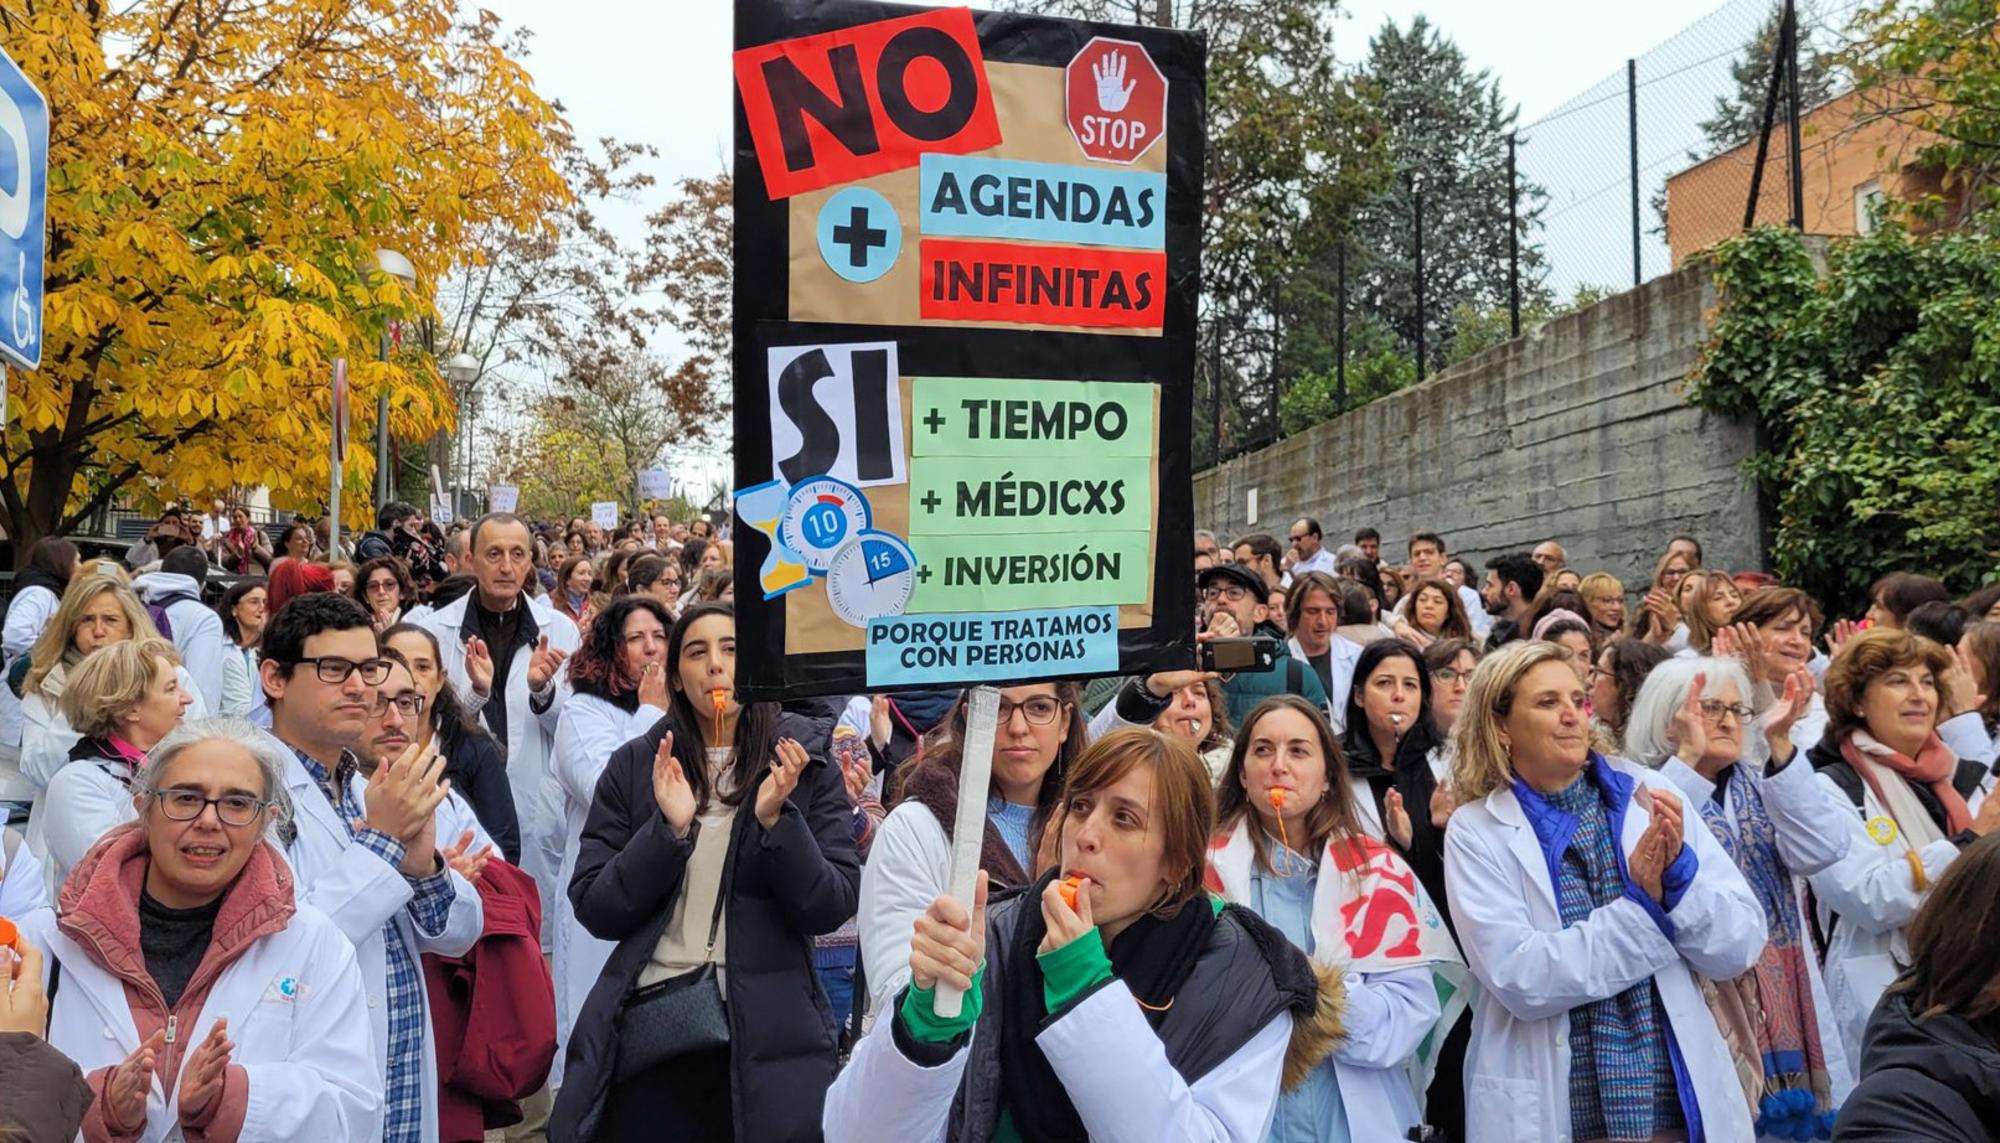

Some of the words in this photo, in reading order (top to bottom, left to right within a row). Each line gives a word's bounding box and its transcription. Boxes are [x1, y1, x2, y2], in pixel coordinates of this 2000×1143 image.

[761, 26, 978, 172] NO
[1080, 115, 1146, 150] STOP
[931, 172, 1154, 228] AGENDAS
[933, 260, 1152, 311] INFINITAS
[777, 348, 893, 483] SI
[961, 399, 1128, 440] TIEMPO
[956, 471, 1125, 517] MÉDICXS
[809, 510, 838, 538] 10
[871, 551, 891, 571] 15
[944, 544, 1121, 585] INVERSIÓN
[871, 620, 982, 645] PORQUE
[991, 613, 1112, 640] TRATAMOS
[901, 646, 956, 668] CON
[966, 638, 1085, 665] PERSONAS
